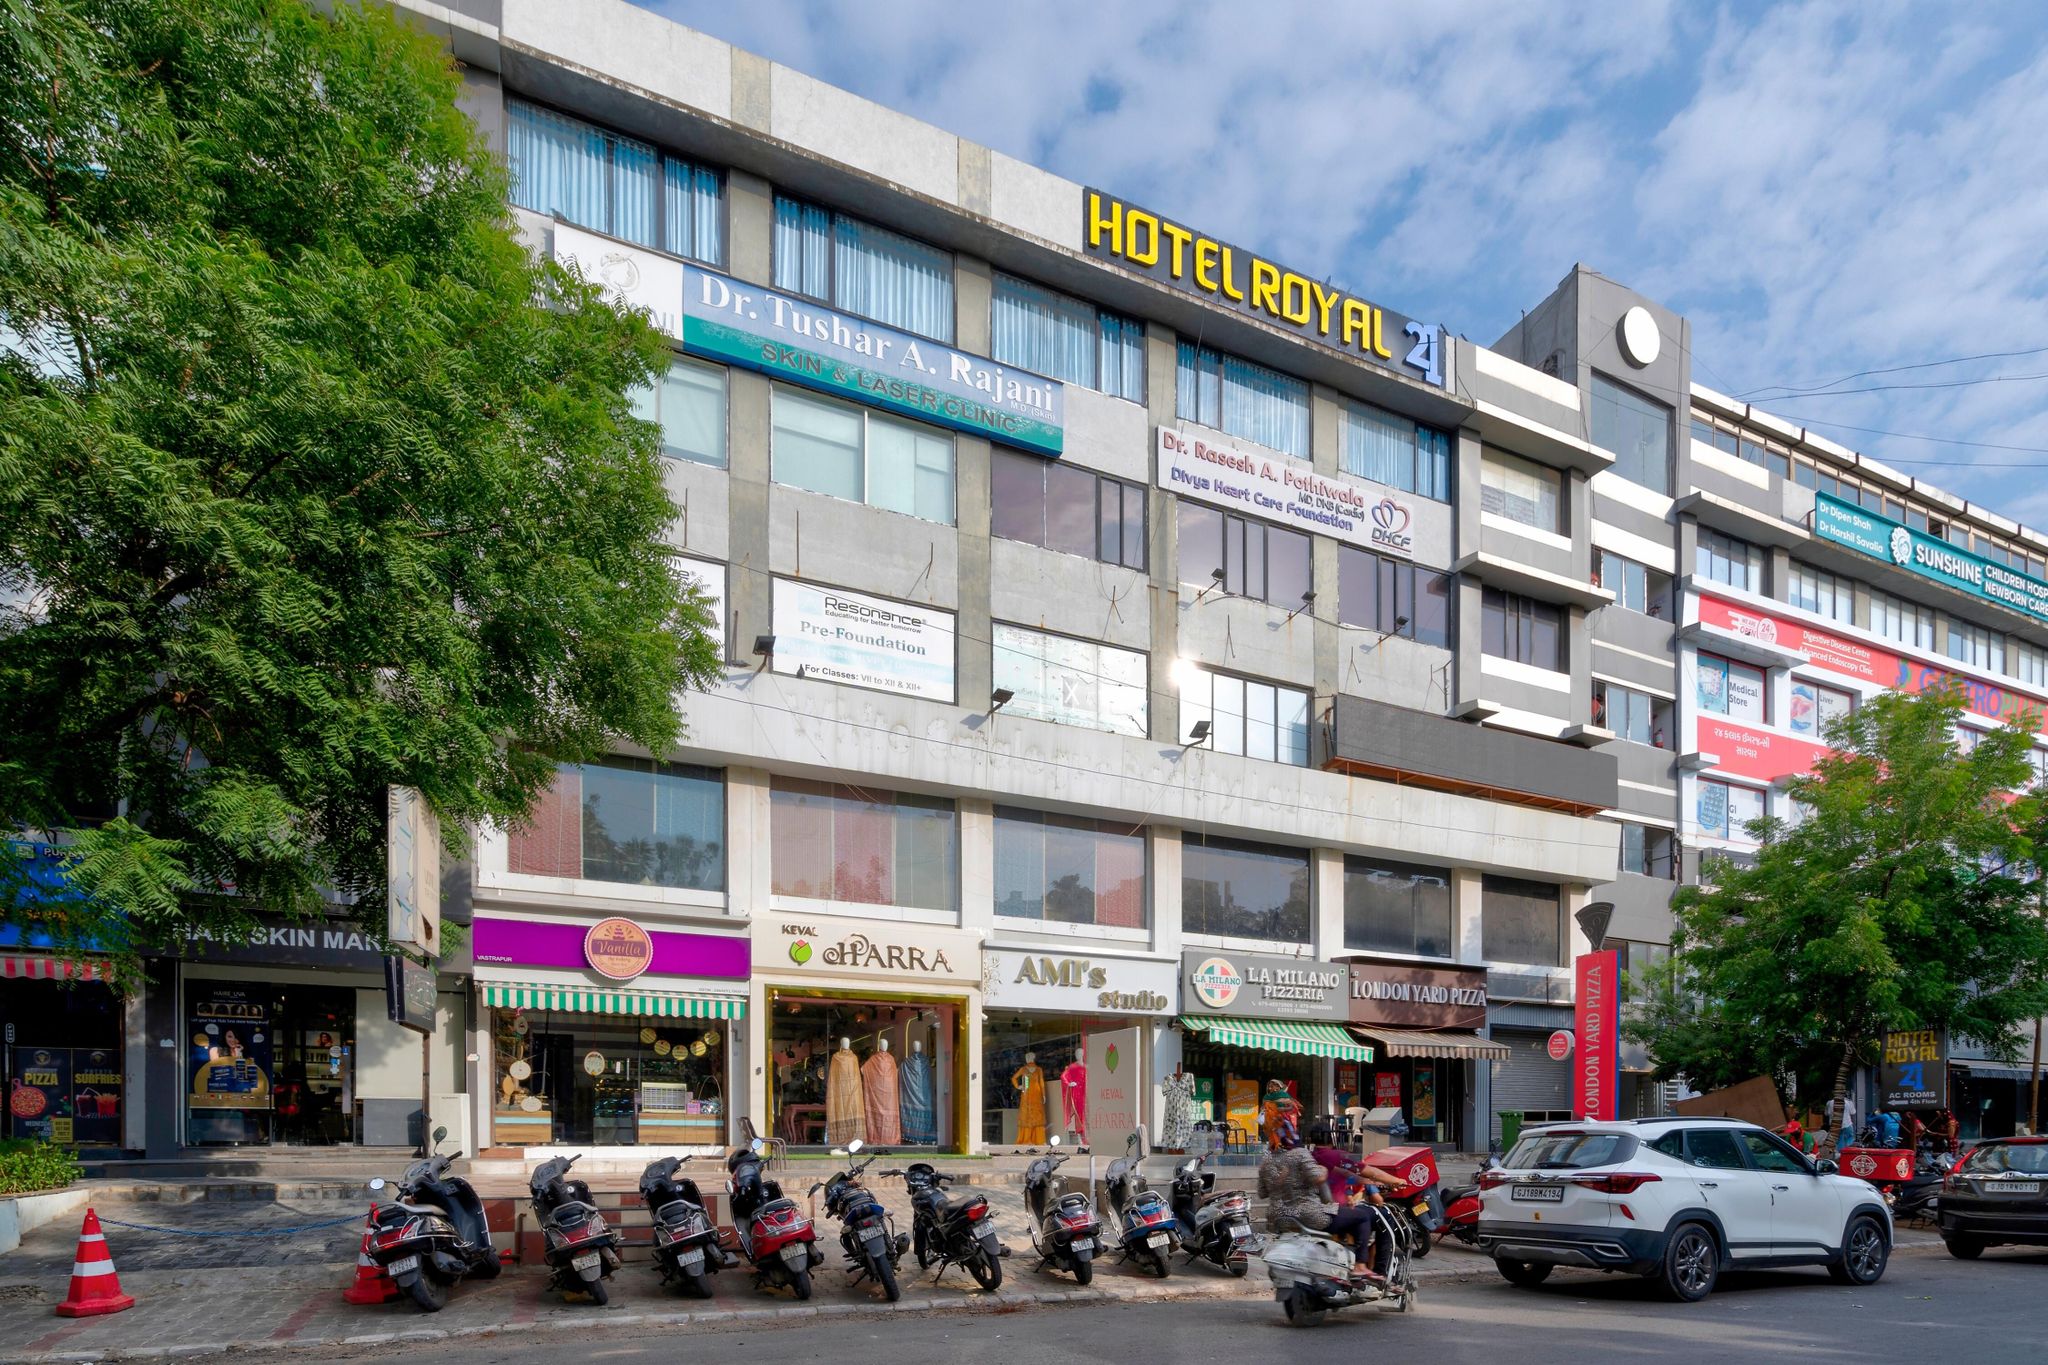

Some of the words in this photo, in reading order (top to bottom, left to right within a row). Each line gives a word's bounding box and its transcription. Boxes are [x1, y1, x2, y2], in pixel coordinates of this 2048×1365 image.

[1089, 193, 1243, 302] HOTEL
[1251, 258, 1392, 360] ROYAL
[1403, 321, 1442, 386] 21
[700, 272, 758, 320] Dr.
[766, 294, 892, 360] Tushar
[899, 341, 936, 375] A.
[949, 352, 1054, 413] Rajani
[761, 343, 822, 377] SKIN
[833, 367, 847, 383] &
[857, 375, 937, 410] LASER
[944, 398, 1019, 434] CLINIC
[1163, 431, 1188, 456] Dr.
[1195, 441, 1256, 475] Rasesh
[1260, 462, 1278, 482] A.
[1171, 467, 1210, 490] Divya
[1214, 479, 1250, 501] Heart
[1254, 492, 1283, 511] Care
[1286, 501, 1354, 532] Foundation
[1316, 497, 1335, 511] DNB
[1819, 502, 1830, 514] Dr
[1830, 505, 1852, 526] Dipen
[1853, 514, 1872, 532] Shah
[1372, 527, 1412, 547] DHCF
[1819, 519, 1830, 533] Dr
[1830, 523, 1856, 546] Harshil
[1856, 533, 1884, 554] Savalia
[1916, 544, 1982, 585] SUNSHINE
[1985, 565, 2026, 591] CHILDREN
[1985, 581, 2027, 607] NEWBORN
[825, 596, 922, 628] Resonance
[825, 609, 859, 623] Educating
[860, 616, 869, 624] for
[870, 618, 890, 628] better
[890, 623, 922, 634] tomorrow
[800, 620, 926, 656] Pre-Foundation
[1740, 626, 1757, 639] OPEN
[1803, 630, 1831, 647] Digestive
[1831, 638, 1852, 653] Disease
[1852, 644, 1871, 659] Centre
[1799, 647, 1829, 662] Advanced
[1828, 652, 1859, 673] Endoscopy
[1859, 663, 1873, 676] Clinic
[804, 663, 820, 674] For
[822, 667, 859, 681] Classes:
[873, 676, 883, 685] to
[884, 678, 896, 688] XII
[897, 680, 904, 689] &
[1728, 694, 1748, 707] Store
[1729, 682, 1759, 698] Medical
[1819, 694, 1834, 705] Liver
[249, 926, 315, 948] SKIN
[781, 924, 818, 937] KEVAL
[477, 954, 513, 962] VASTRAPUR
[598, 941, 641, 956] Vanilla
[1014, 955, 1108, 989] AMI's
[1195, 975, 1206, 983] LA
[1208, 976, 1241, 986] MILANO
[1247, 967, 1271, 983] LA
[1275, 968, 1340, 988] MILANO
[1097, 989, 1168, 1012] studio
[1264, 986, 1325, 1000] PIZZERIA
[1352, 980, 1410, 1001] LONDON
[1410, 985, 1448, 1005] YARD
[1449, 987, 1487, 1007] PIZZA
[1586, 965, 1602, 1011] PIZZA
[1585, 1013, 1600, 1052] YARD
[1887, 1030, 1938, 1047] HOTEL
[1885, 1045, 1940, 1063] ROYAL
[24, 1073, 59, 1086] PIZZA
[1583, 1056, 1600, 1121] LONDON
[1899, 1062, 1925, 1091] 21
[1100, 1088, 1124, 1100] KEVAL
[1903, 1091, 1936, 1099] ROOMS
